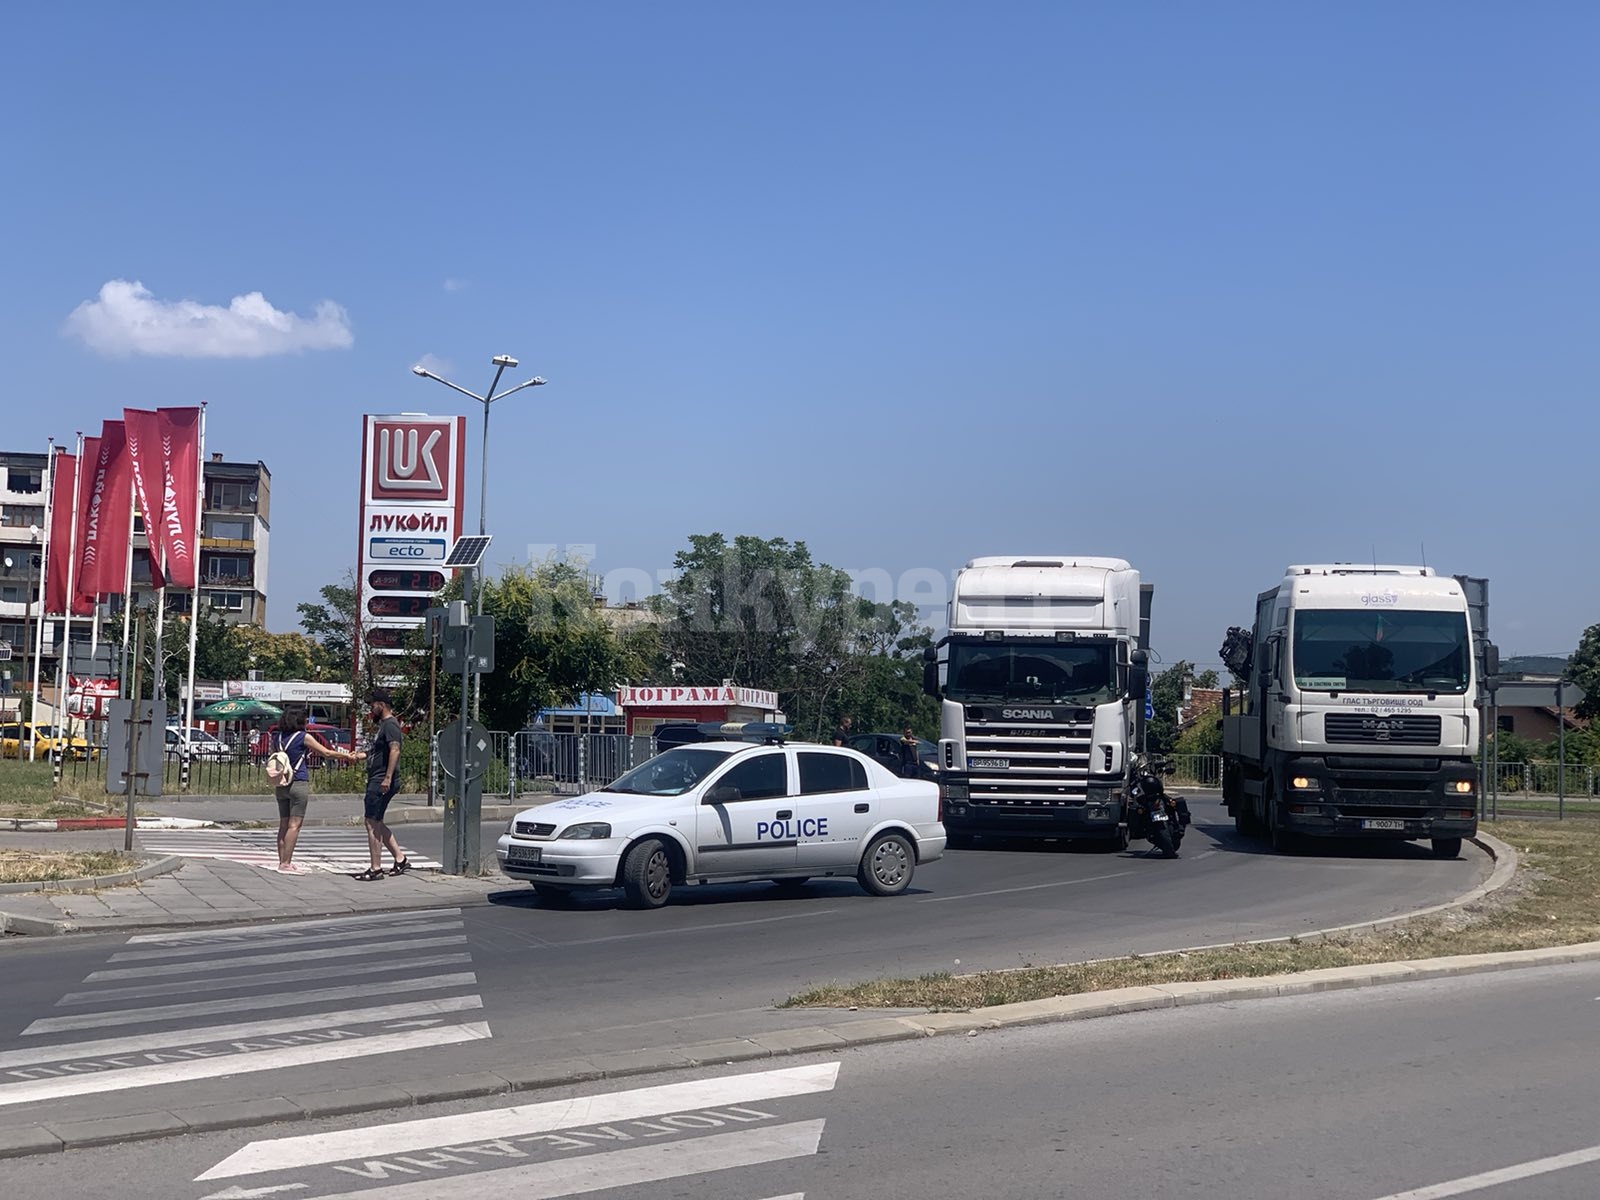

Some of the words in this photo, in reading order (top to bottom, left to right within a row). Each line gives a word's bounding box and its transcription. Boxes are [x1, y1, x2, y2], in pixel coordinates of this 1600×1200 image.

[369, 512, 448, 532] ЛУКОЙЛ
[389, 545, 424, 556] ecto
[1342, 697, 1361, 705] ГЛАС
[1362, 698, 1406, 706] ТЪРГОВИЩЕ
[1407, 699, 1424, 707] ООД
[1002, 709, 1054, 720] SCANIA
[1362, 720, 1404, 729] MAN
[757, 818, 828, 840] POLICE
[5, 1028, 366, 1080] ПОГЛЕДНИ
[333, 1106, 780, 1180] ПОГЛЕДНИ
